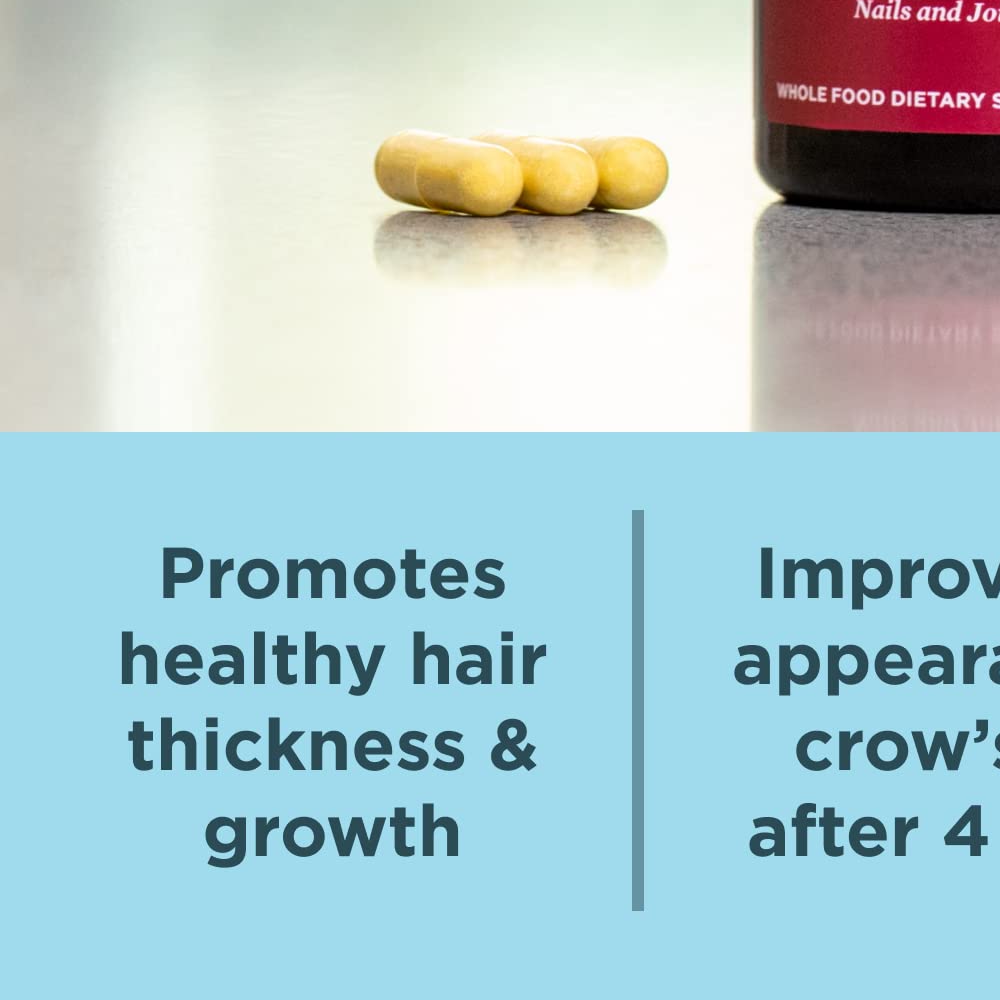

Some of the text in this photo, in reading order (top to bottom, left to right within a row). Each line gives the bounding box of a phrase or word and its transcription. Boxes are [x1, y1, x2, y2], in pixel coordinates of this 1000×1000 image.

[916, 0, 964, 22] and
[776, 82, 827, 103] WHOLE
[831, 87, 886, 106] FOOD
[891, 90, 986, 109] DIETARY
